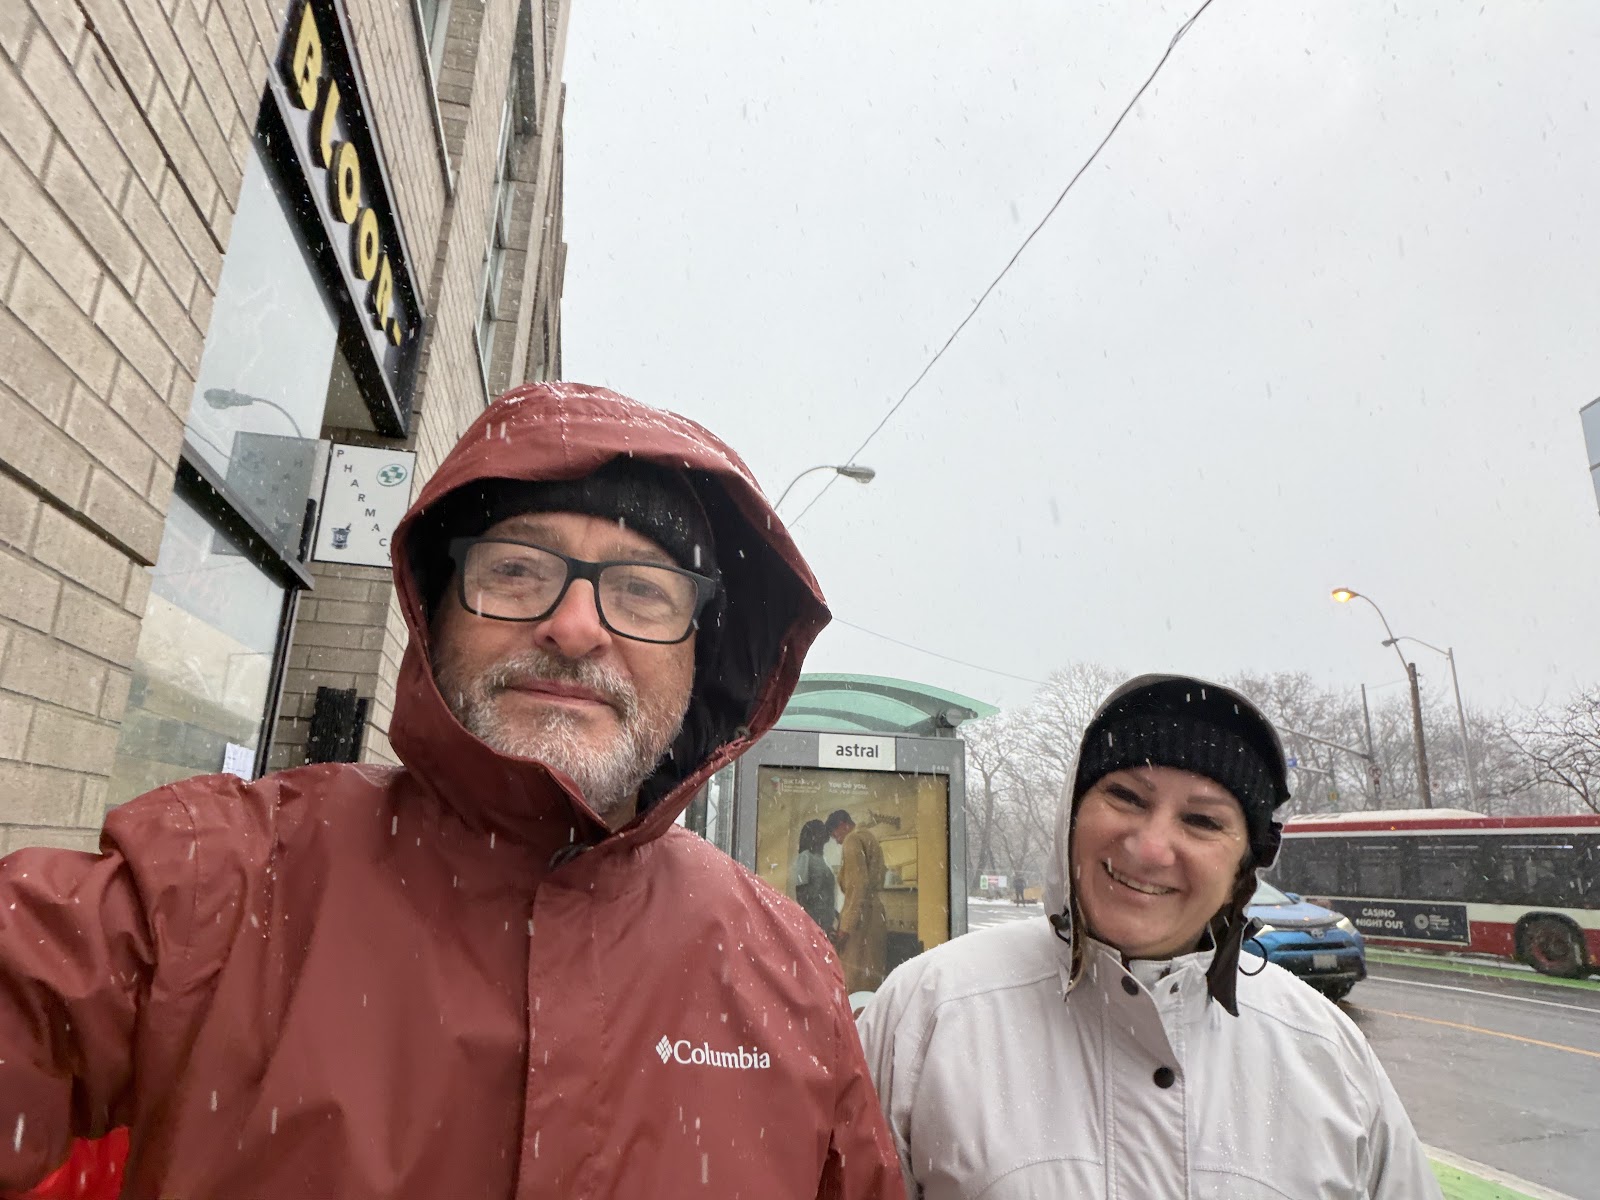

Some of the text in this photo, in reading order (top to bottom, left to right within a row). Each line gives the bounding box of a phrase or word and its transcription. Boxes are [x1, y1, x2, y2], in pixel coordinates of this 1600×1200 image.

[835, 743, 879, 758] astral
[1361, 907, 1396, 918] CASINO
[1355, 918, 1404, 929] NIGHT OUT
[673, 1039, 771, 1069] Columbia
